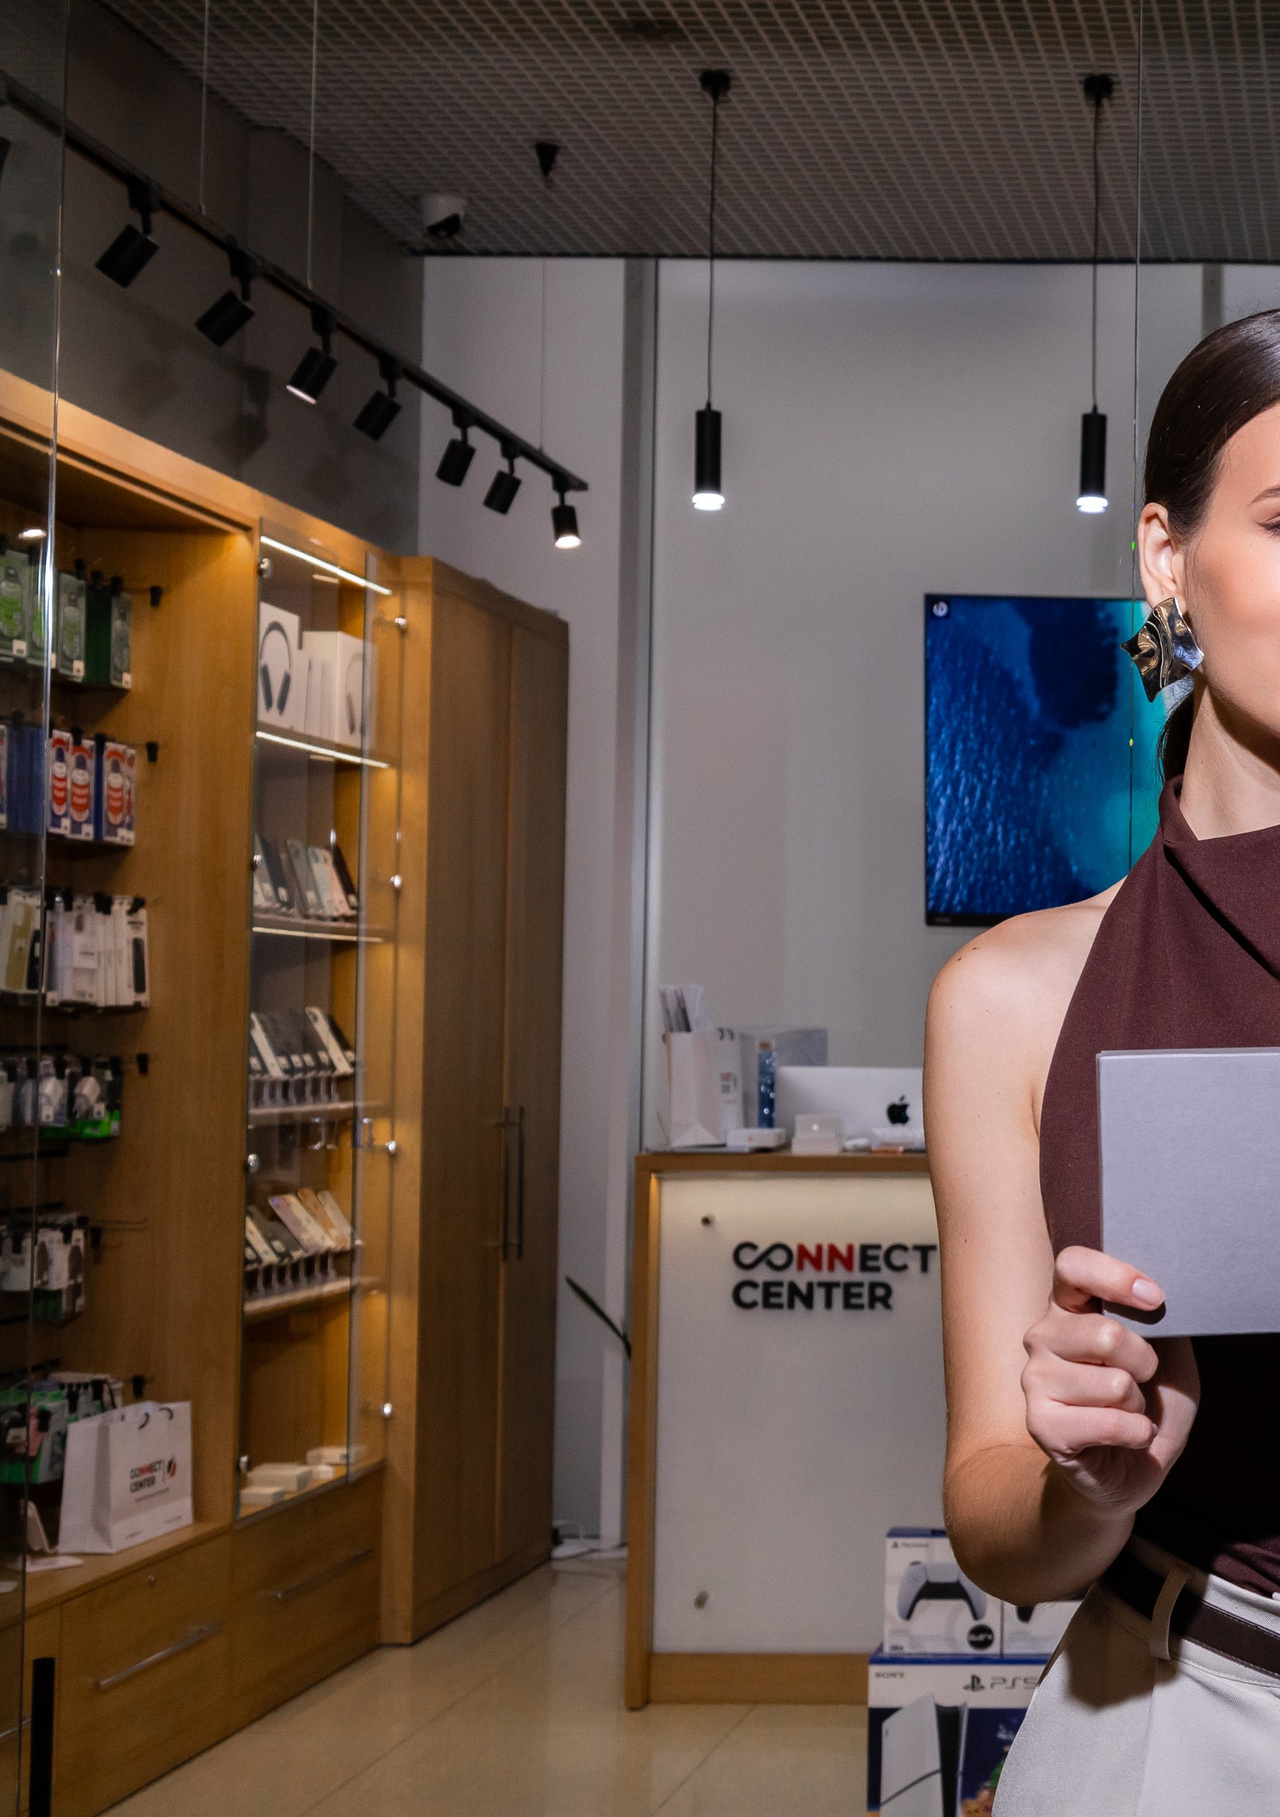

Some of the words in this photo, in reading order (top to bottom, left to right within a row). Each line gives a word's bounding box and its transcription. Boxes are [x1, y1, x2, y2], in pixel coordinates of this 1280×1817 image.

[732, 1241, 938, 1274] CONNECT
[731, 1279, 893, 1311] CENTER
[875, 1671, 905, 1680] SONY
